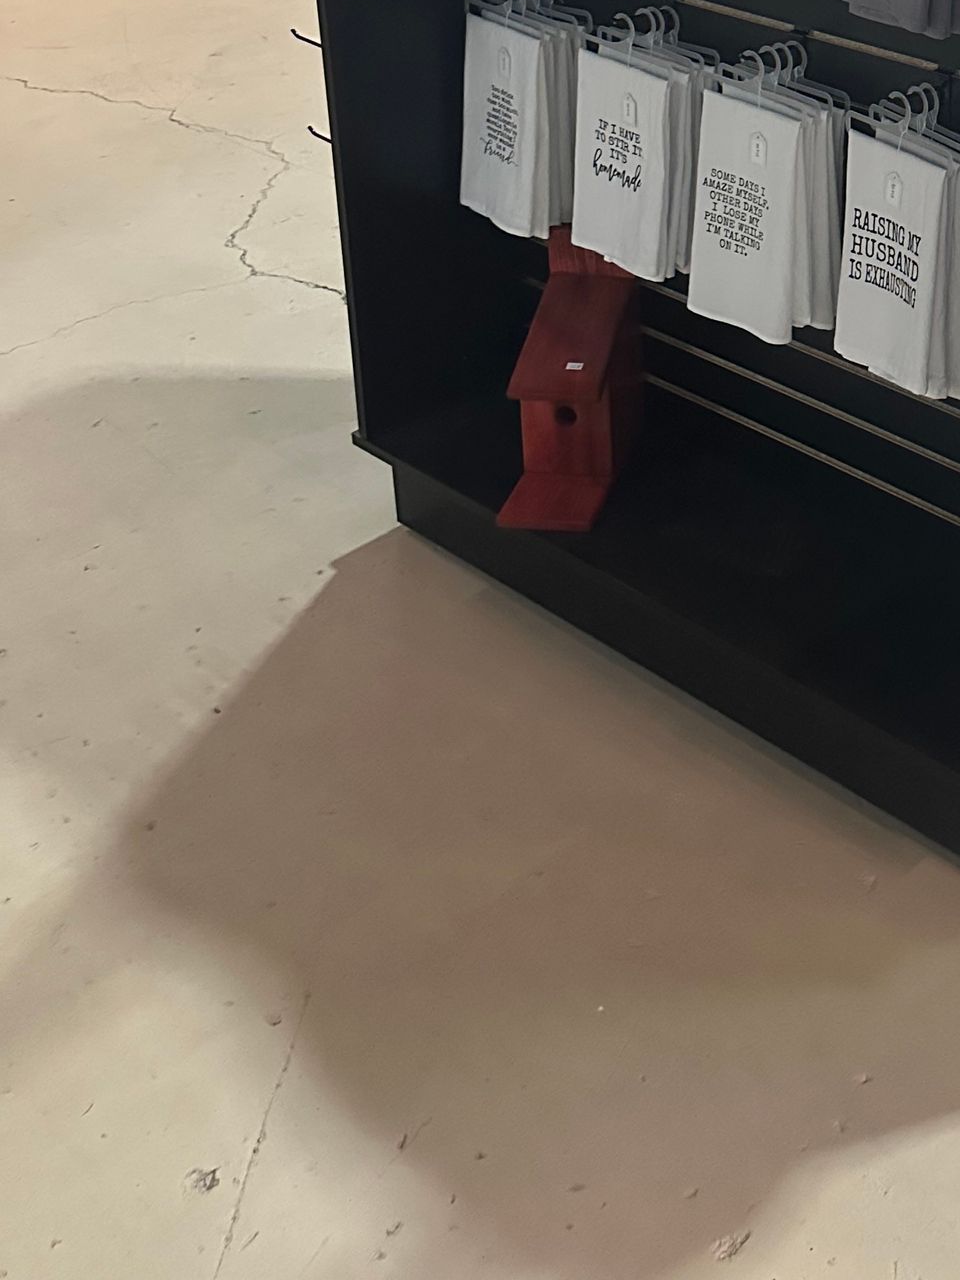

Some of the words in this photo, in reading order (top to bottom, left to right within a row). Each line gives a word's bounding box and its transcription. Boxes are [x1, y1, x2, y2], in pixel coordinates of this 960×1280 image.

[595, 129, 606, 143] TO
[632, 144, 643, 158] IT
[610, 124, 616, 135] I
[619, 126, 640, 144] HAVE
[593, 148, 642, 192] homemade
[710, 168, 737, 184] SOME
[738, 177, 759, 193] DAYS
[760, 186, 766, 197] I
[702, 177, 734, 194] AMAZE
[735, 187, 769, 210] MYSELF.
[709, 190, 741, 208] OTHER
[743, 201, 763, 218] DAYS
[704, 210, 735, 229] PHONE
[738, 222, 764, 241] WHILE
[712, 202, 718, 212] I
[723, 205, 747, 222] LOSE
[749, 215, 760, 228] MY
[706, 222, 721, 235] I'M
[723, 228, 761, 251] TALKING
[852, 207, 905, 246] RAISING
[907, 231, 922, 256] MY
[719, 238, 732, 250] ON
[734, 243, 748, 257] IT.
[850, 233, 919, 282] HUSBAND
[848, 258, 862, 280] IS
[864, 263, 917, 309] EXHAUSTING
